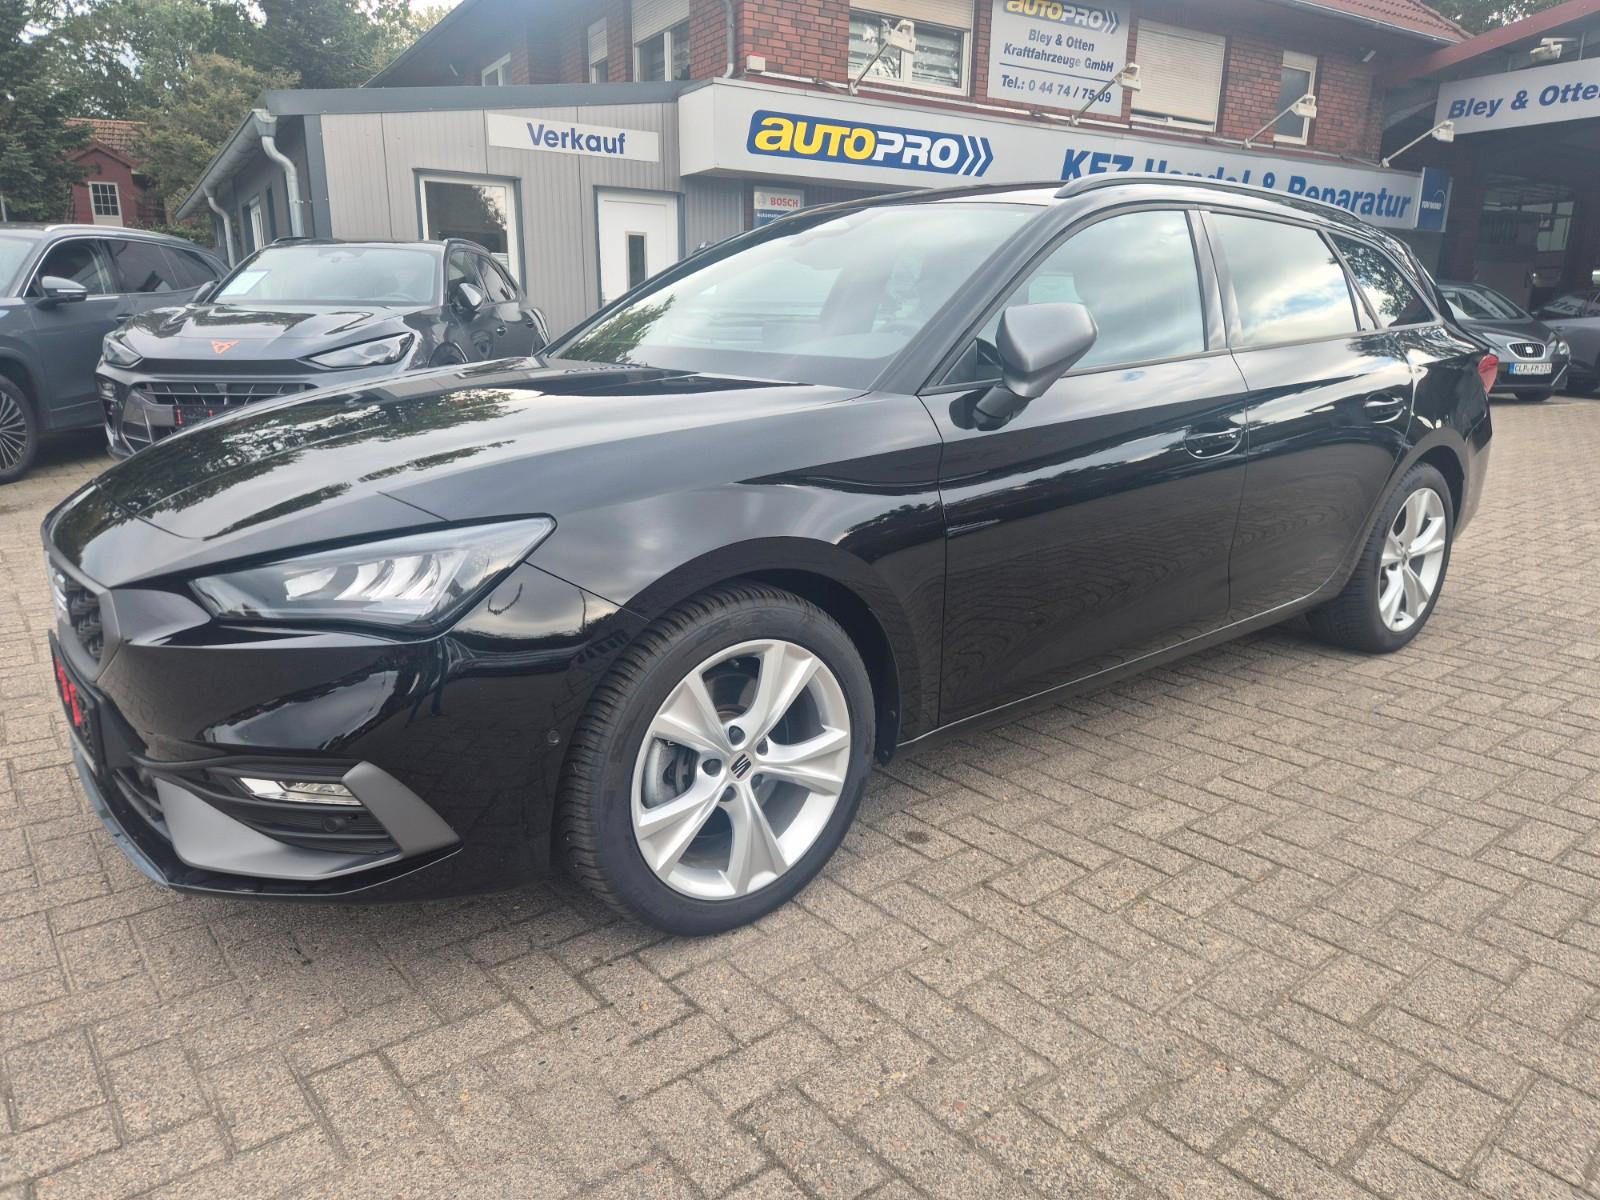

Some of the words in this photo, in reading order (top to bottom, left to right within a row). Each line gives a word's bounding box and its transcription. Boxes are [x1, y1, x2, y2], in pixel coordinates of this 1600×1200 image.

[1028, 29, 1052, 45] Bley
[1055, 34, 1063, 46] &
[1066, 38, 1095, 52] Otten
[1003, 43, 1081, 68] Kraftfahrzeuge
[1084, 57, 1114, 73] GmbH
[1001, 74, 1025, 90] Tel.:
[1028, 80, 1036, 92] 0
[1039, 82, 1053, 94] 44
[1057, 84, 1071, 97] 74
[1448, 97, 1504, 119] Bley
[1510, 90, 1529, 110] &
[1538, 82, 1600, 106] Otte
[526, 122, 626, 154] Verkauf
[770, 196, 799, 208] BOSCH
